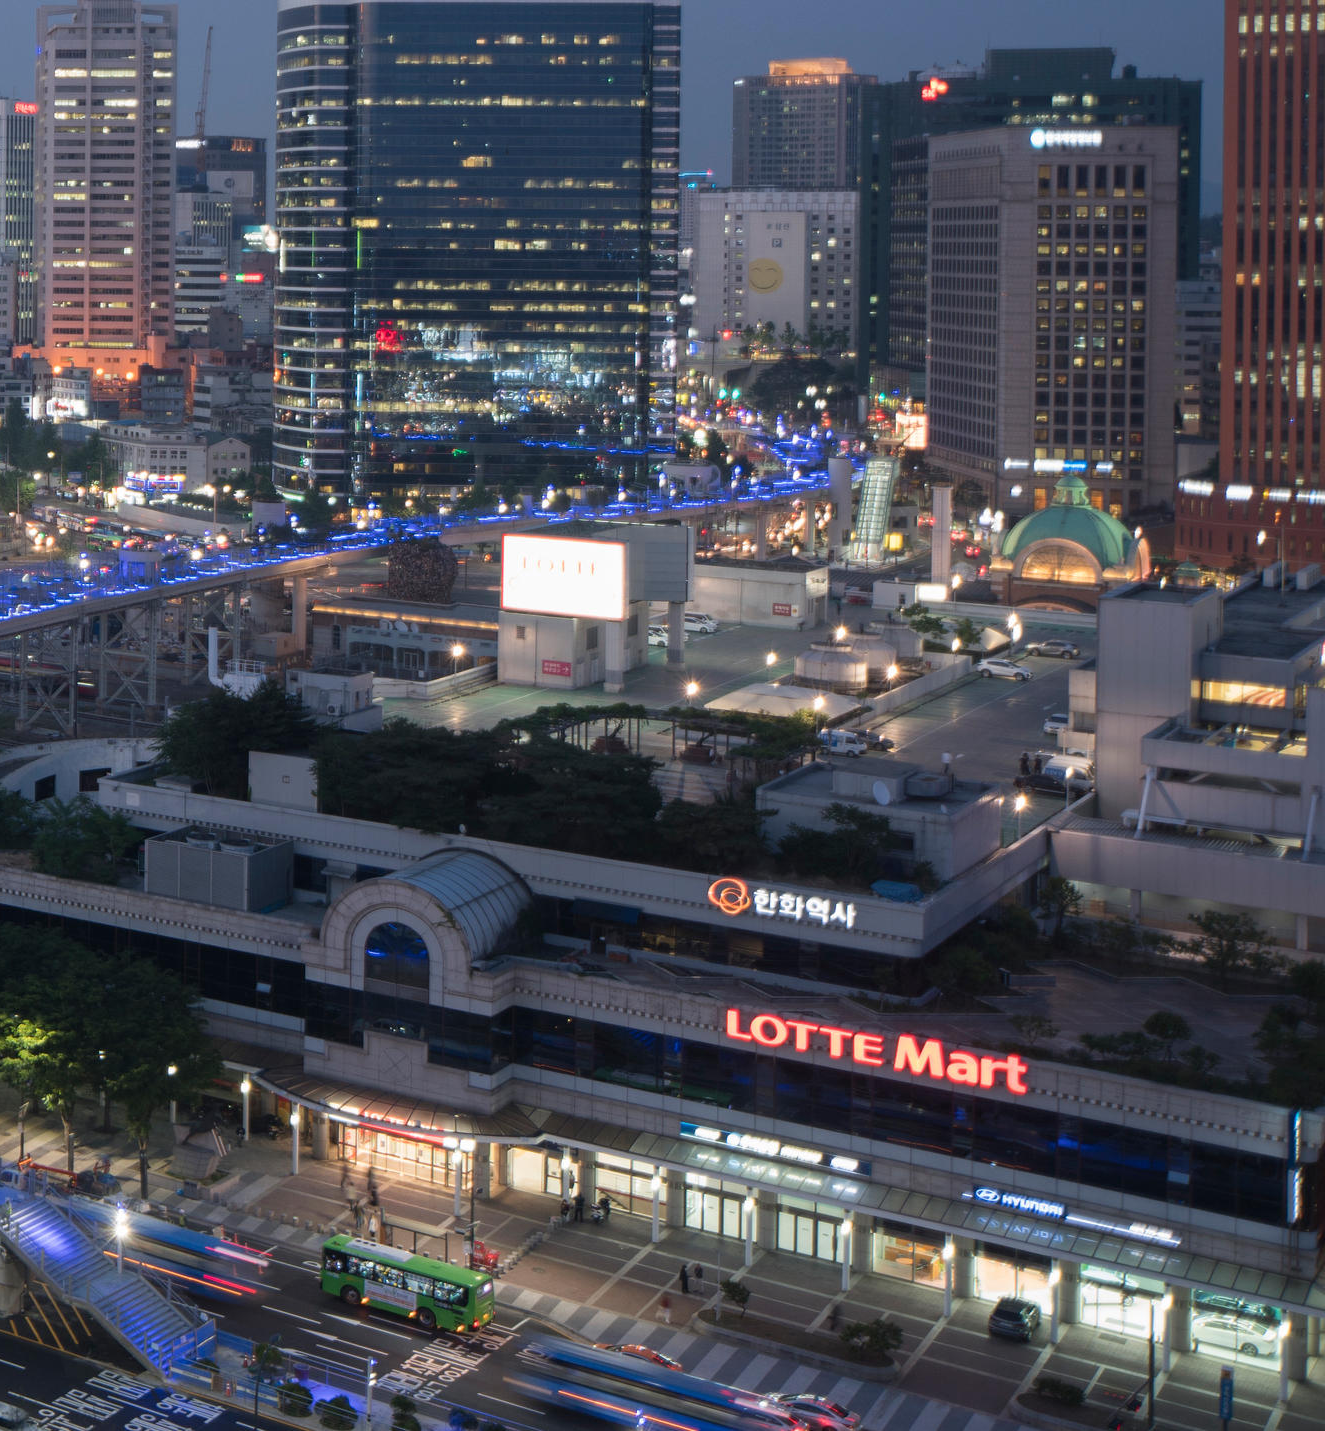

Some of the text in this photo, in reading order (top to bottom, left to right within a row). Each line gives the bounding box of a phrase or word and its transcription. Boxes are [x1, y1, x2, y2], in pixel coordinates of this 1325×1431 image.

[922, 89, 935, 98] SK
[753, 888, 857, 929] 한화역사
[726, 1008, 1029, 1094] LOTTE Mart
[1001, 1194, 1064, 1218] HYUNDAI
